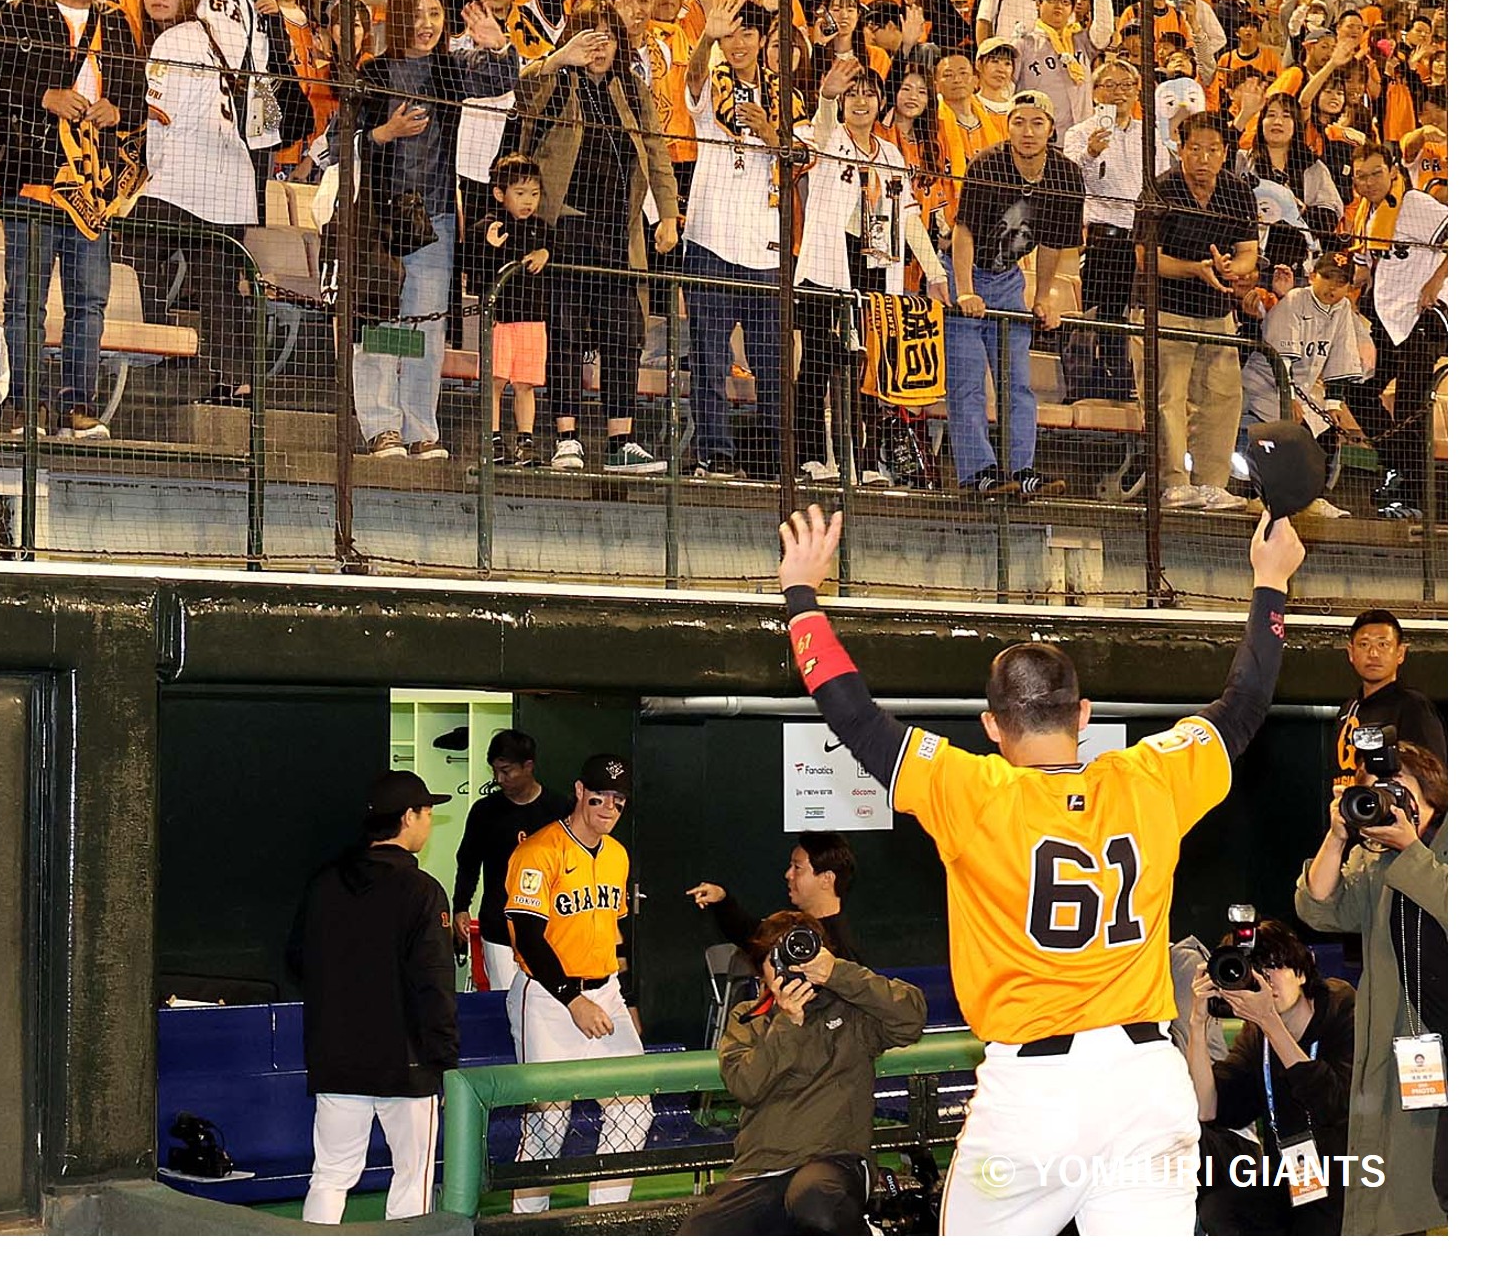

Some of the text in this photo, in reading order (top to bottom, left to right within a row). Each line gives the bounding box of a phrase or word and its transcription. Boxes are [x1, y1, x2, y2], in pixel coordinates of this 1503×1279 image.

[805, 765, 834, 775] Fanatics
[852, 788, 877, 796] docomo
[555, 885, 623, 916] GIANT
[1025, 833, 1146, 953] 61
